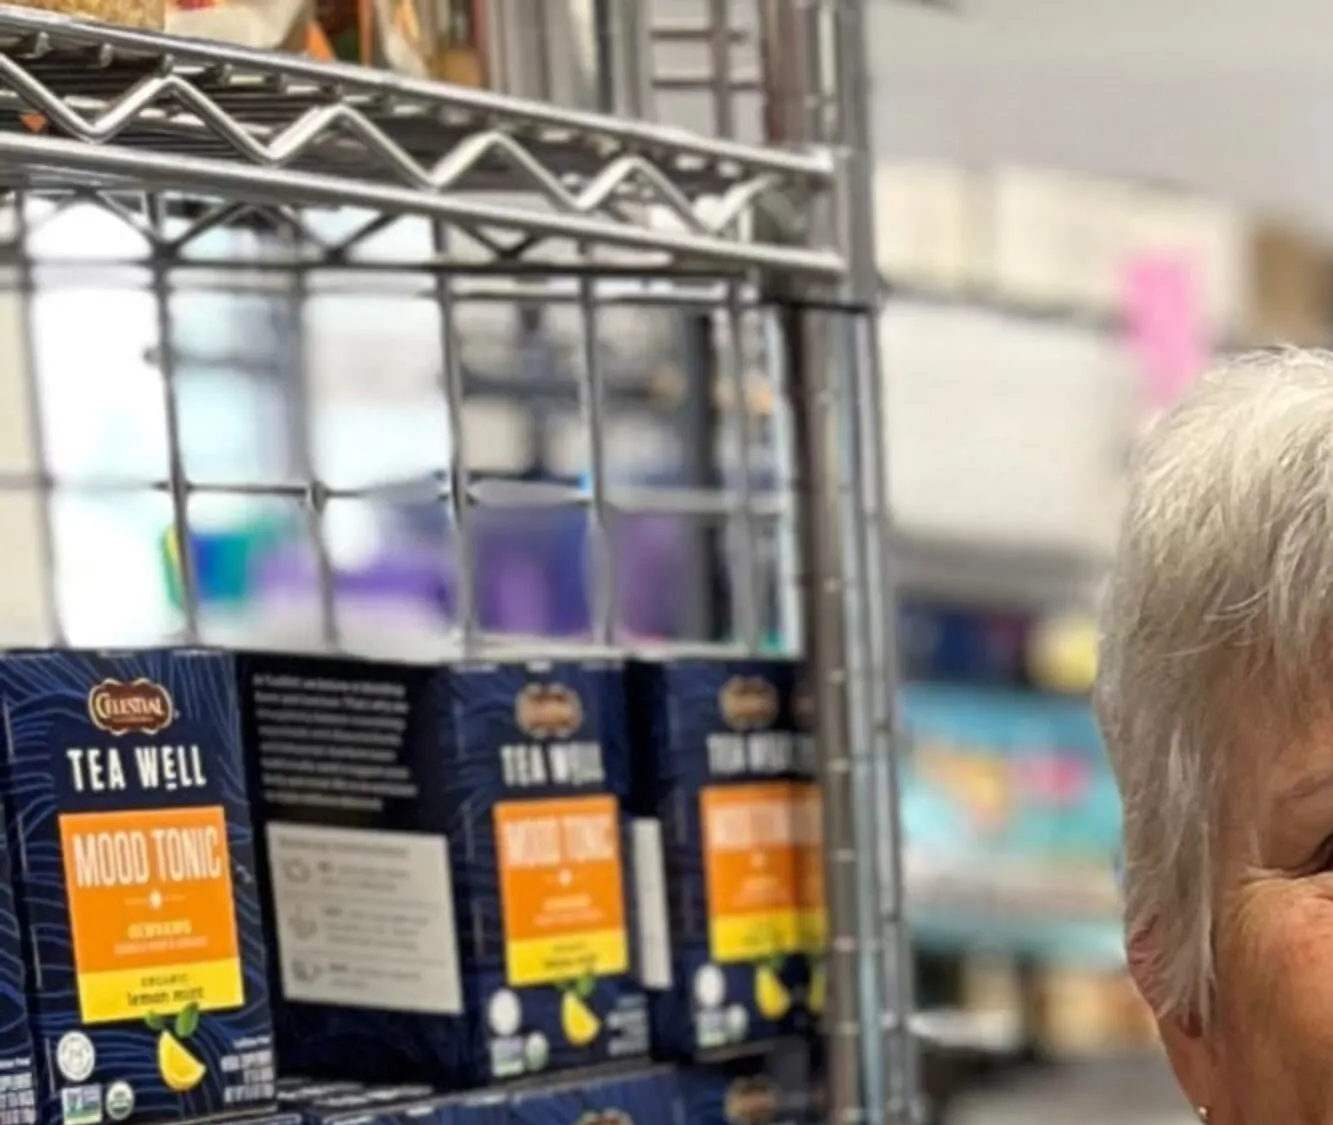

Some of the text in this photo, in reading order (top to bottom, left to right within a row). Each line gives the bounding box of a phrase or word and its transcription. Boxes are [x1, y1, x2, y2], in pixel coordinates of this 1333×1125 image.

[95, 692, 164, 719] CELESTIAL
[66, 744, 207, 792] TEA WELL
[73, 826, 222, 888] MOOD TONIC
[127, 986, 204, 1007] lemon mint
